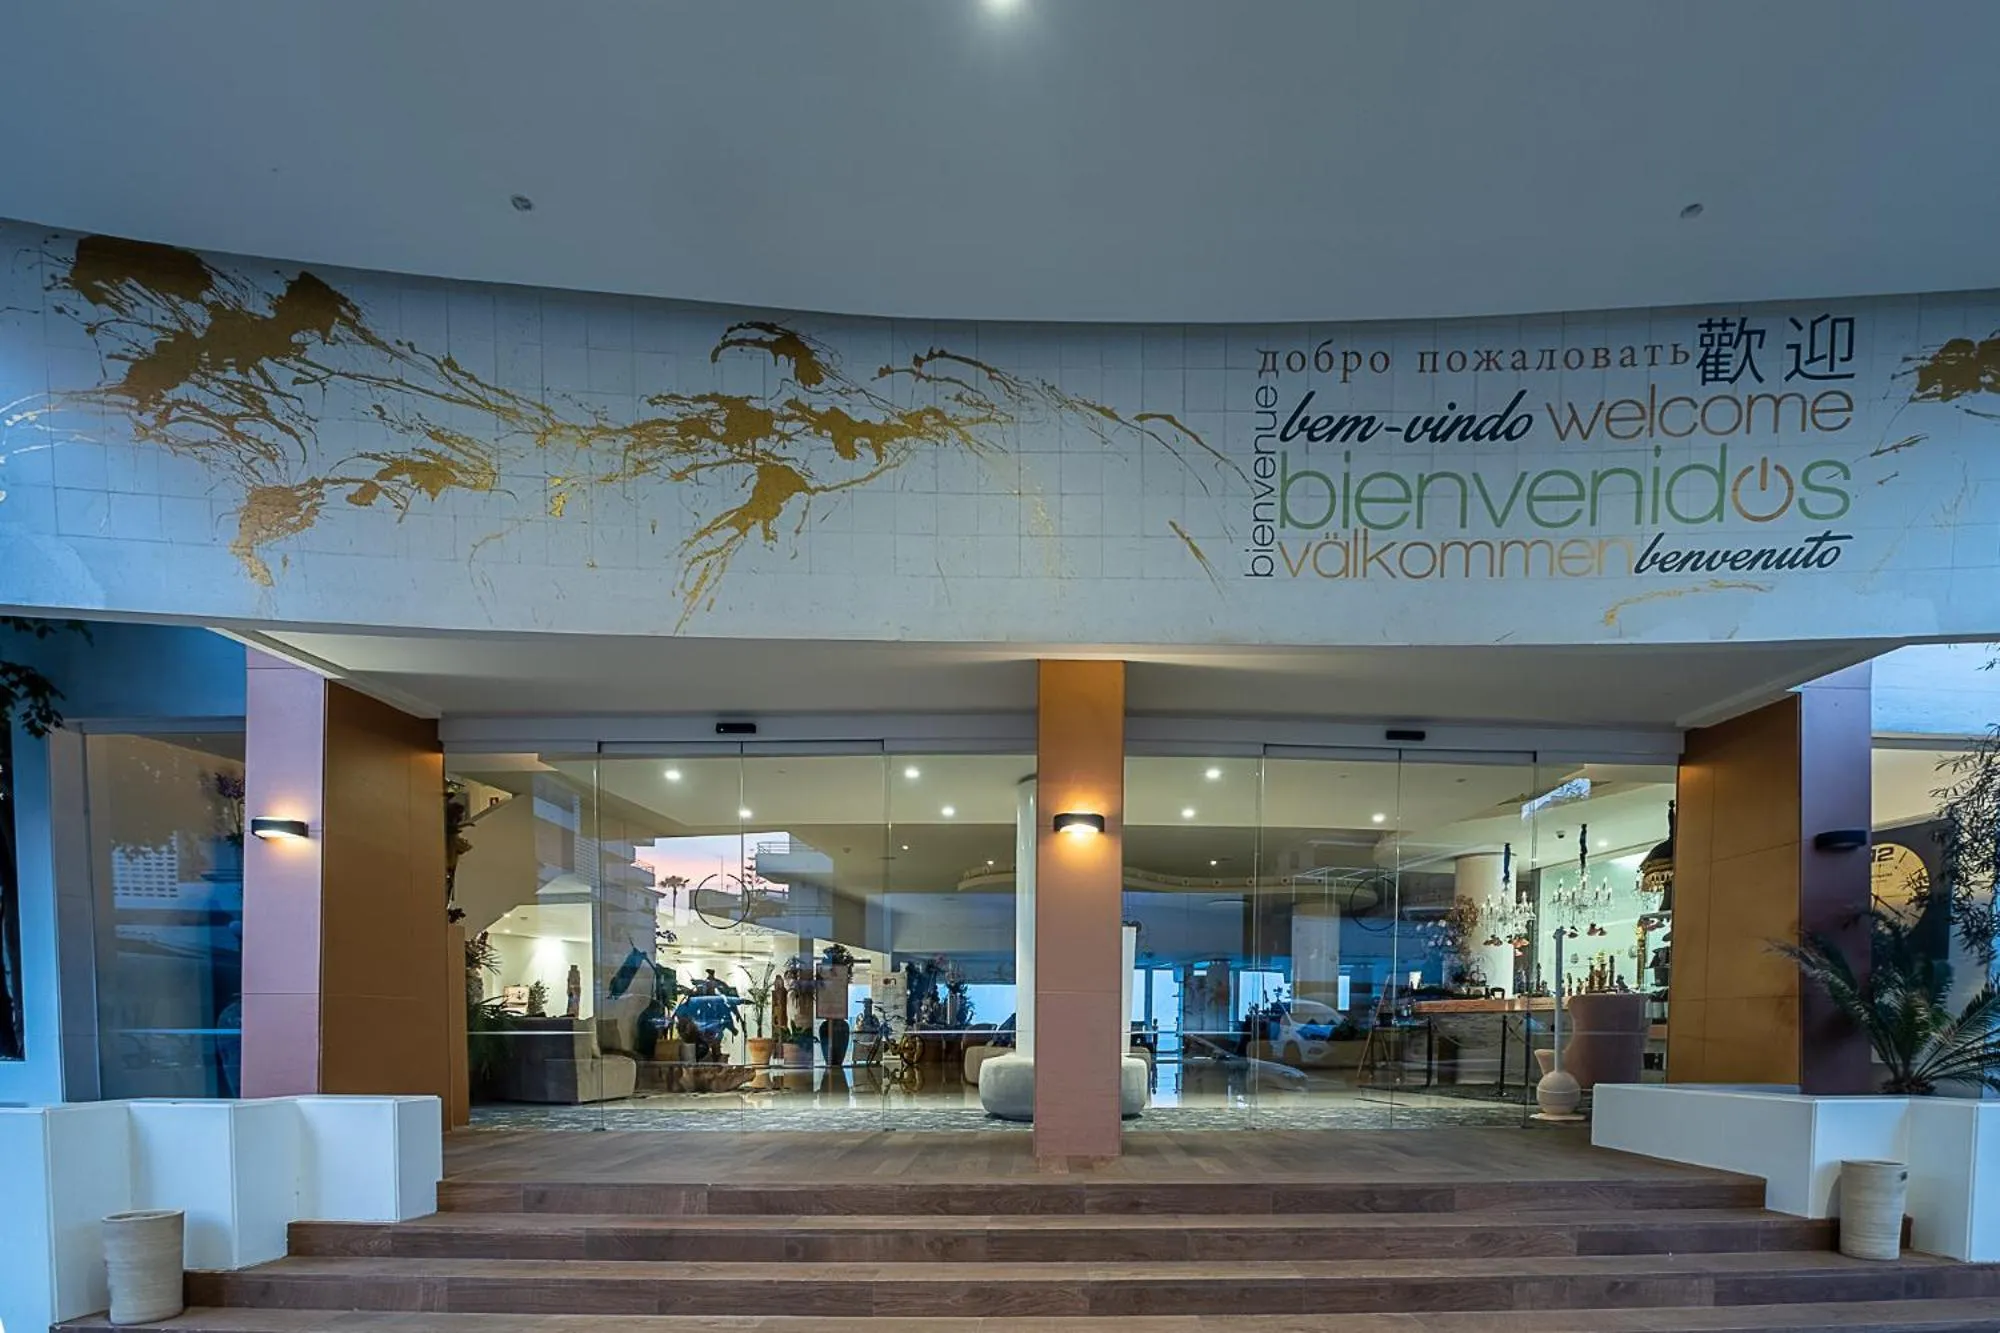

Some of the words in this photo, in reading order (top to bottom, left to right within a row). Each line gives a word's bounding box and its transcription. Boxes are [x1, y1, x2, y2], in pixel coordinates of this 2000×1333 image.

[1256, 338, 1390, 383] добро
[1417, 342, 1690, 374] пожаловать
[1696, 313, 1856, 386] 歡迎
[1279, 390, 1533, 443] bem-vindo
[1545, 383, 1854, 441] welcome
[1245, 385, 1278, 577] bienvenue
[1279, 443, 1852, 531] bienvenidos
[1277, 527, 1634, 579] välkommen
[1634, 530, 1854, 574] benvenuto
